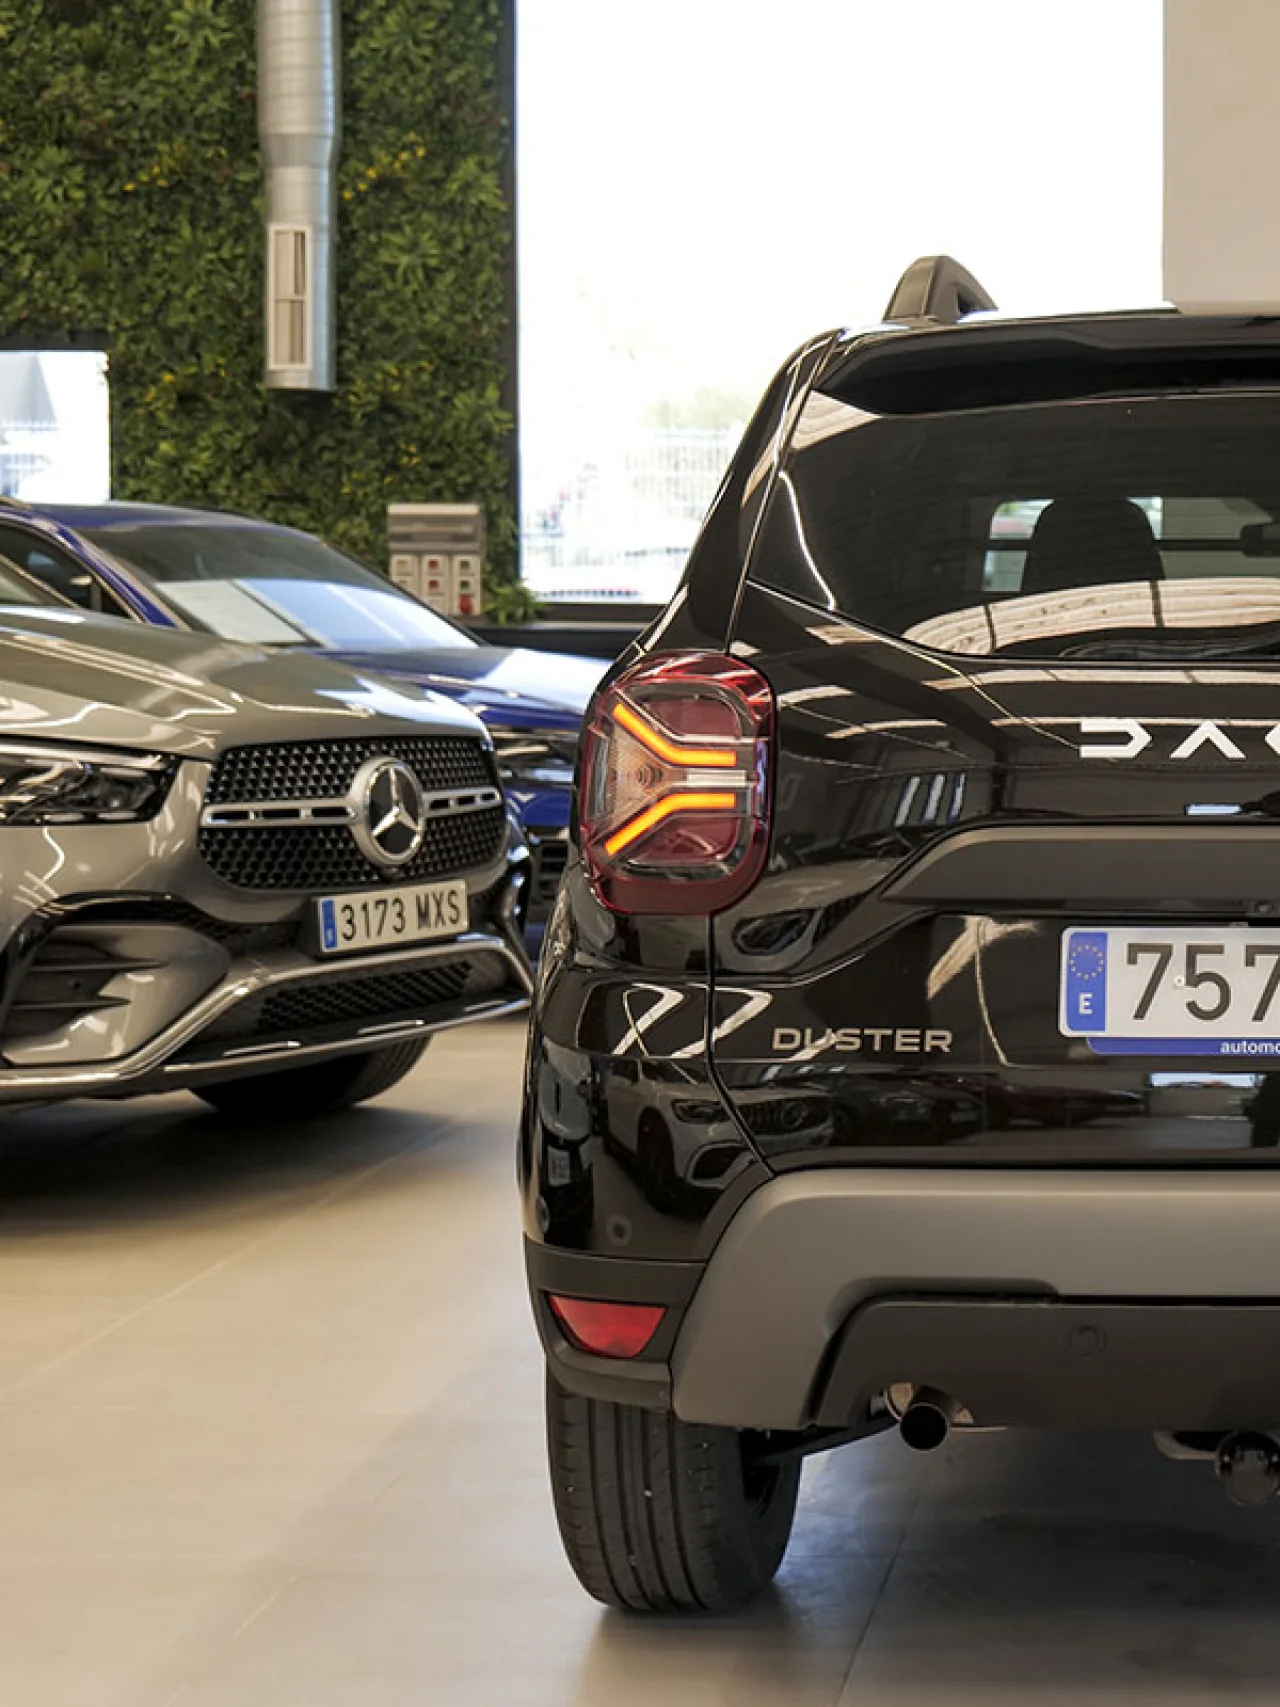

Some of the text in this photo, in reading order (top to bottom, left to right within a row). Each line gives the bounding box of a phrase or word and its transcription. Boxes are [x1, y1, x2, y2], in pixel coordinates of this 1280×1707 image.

[341, 889, 462, 942] 3173 MXS
[1079, 992, 1093, 1015] E
[771, 1027, 954, 1053] DUSTER
